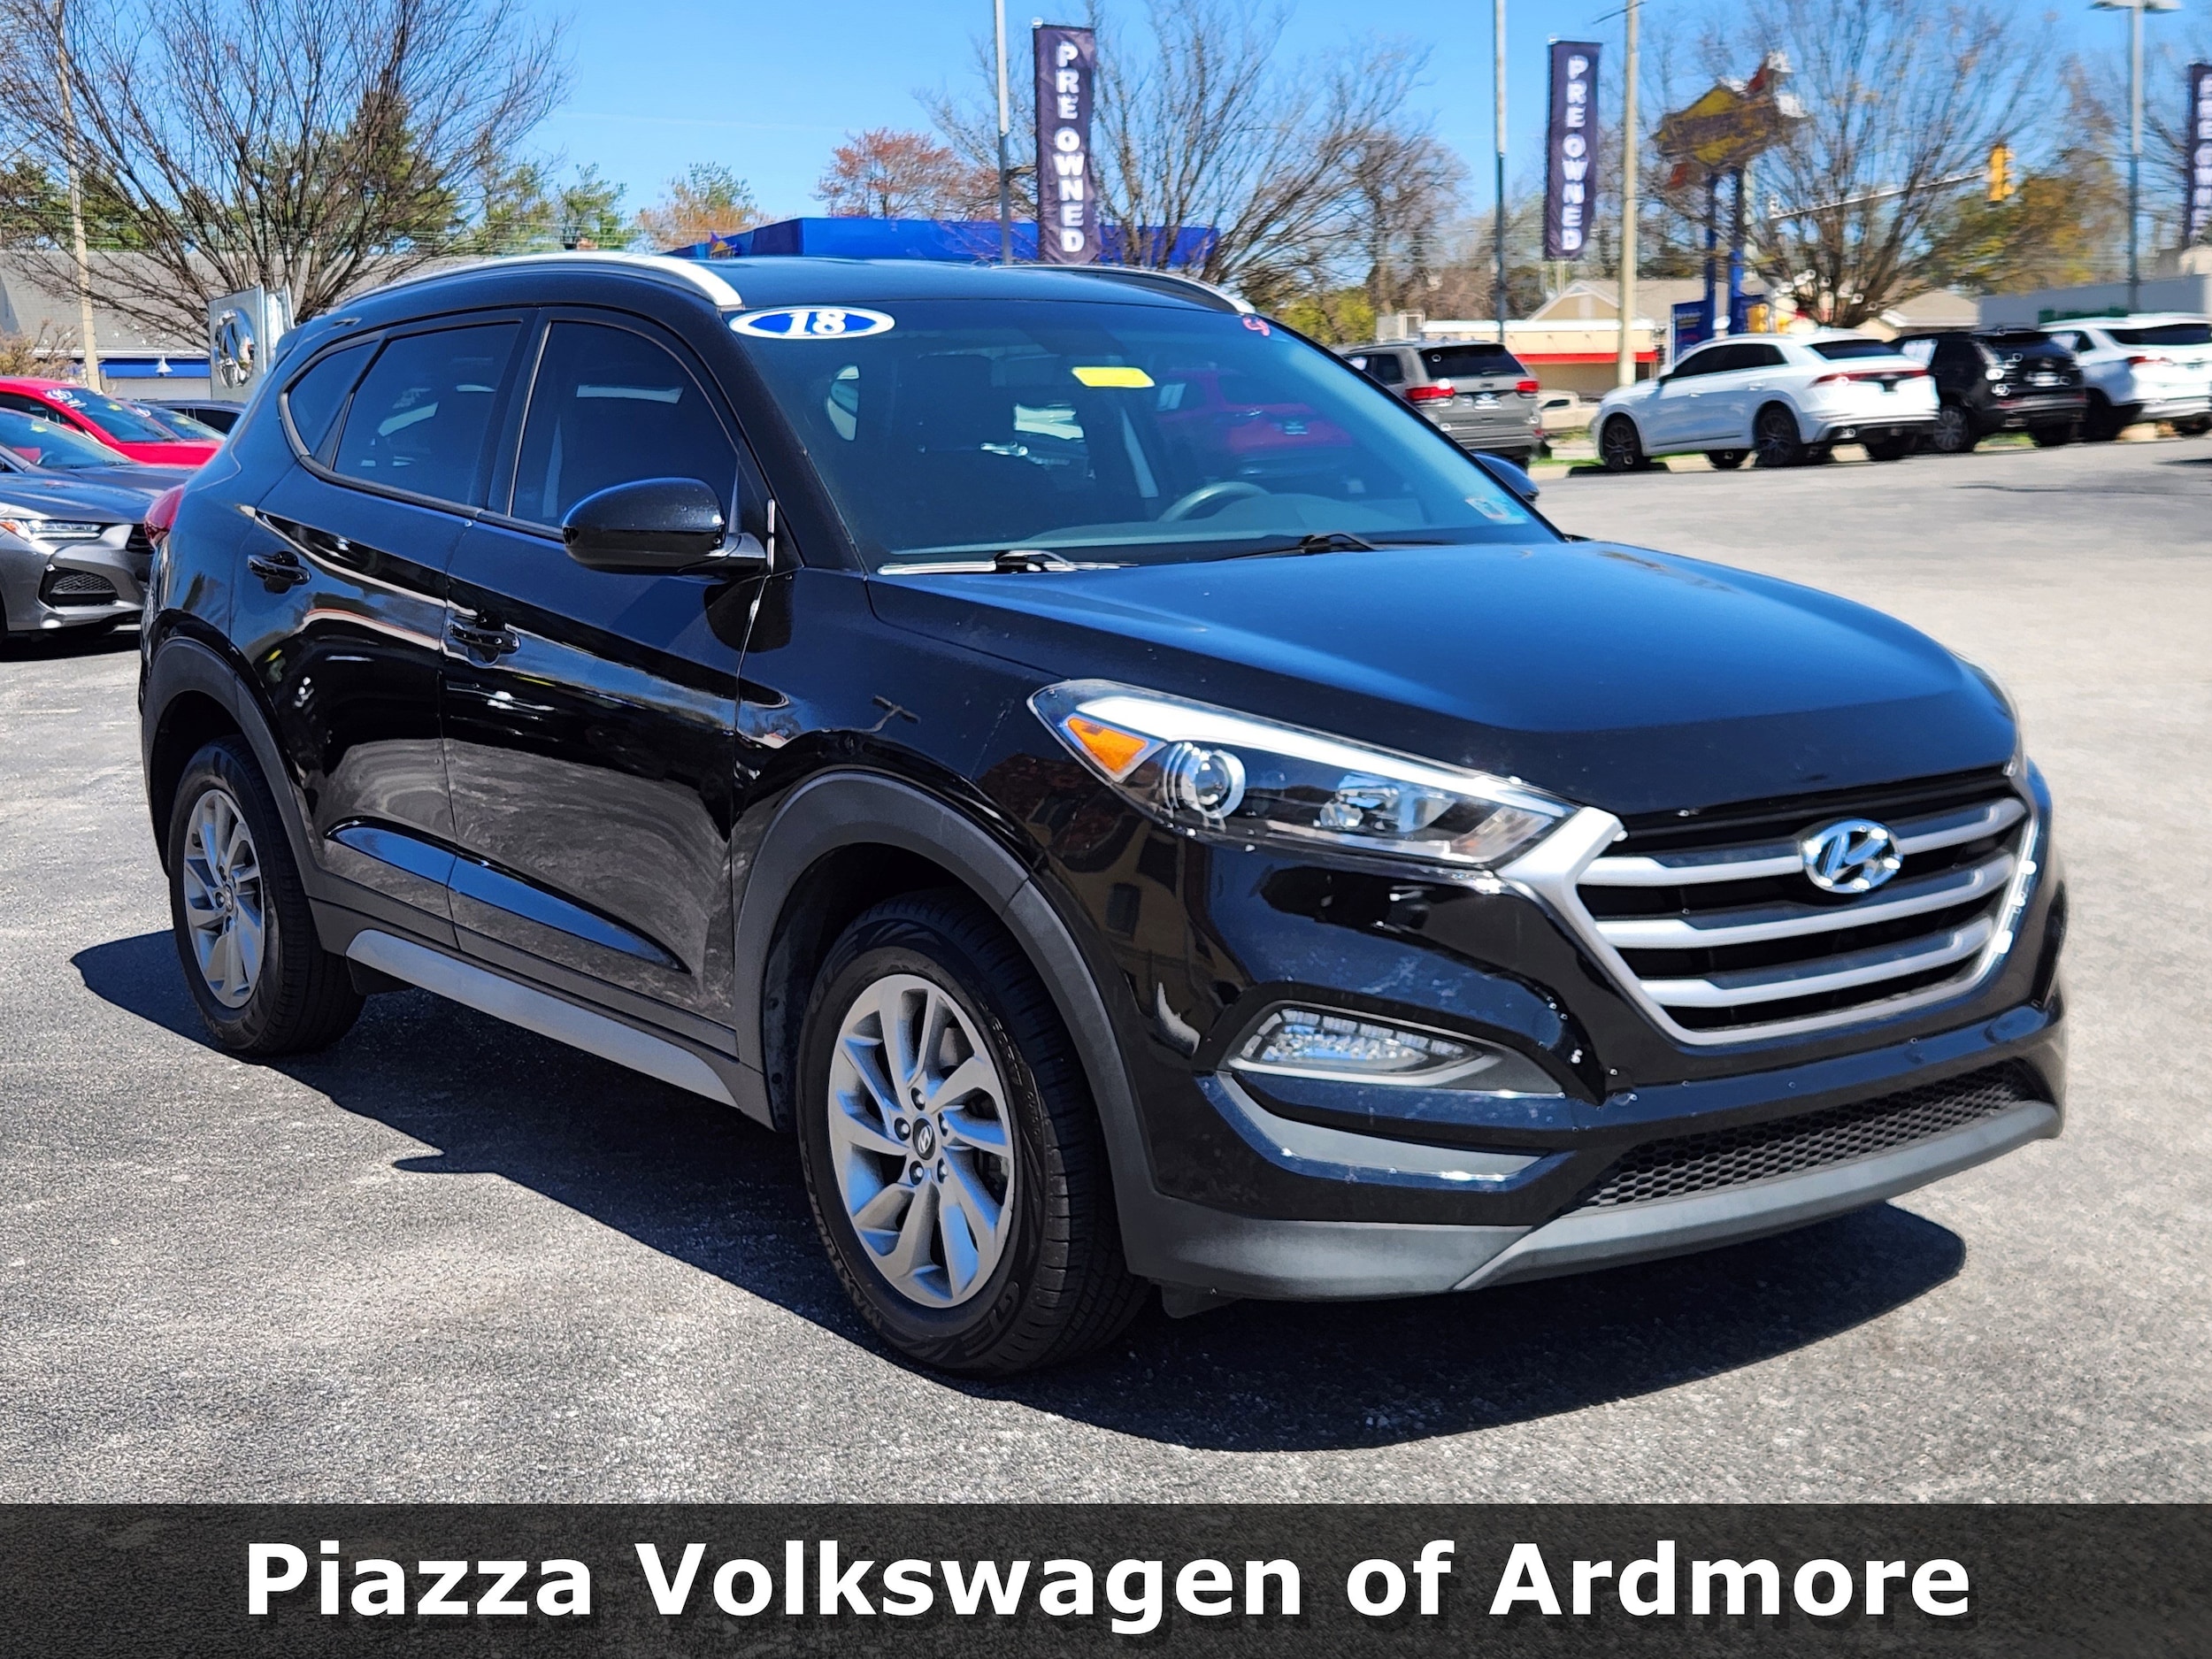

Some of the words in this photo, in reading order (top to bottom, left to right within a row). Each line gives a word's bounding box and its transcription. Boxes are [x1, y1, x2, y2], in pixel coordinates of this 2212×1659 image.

[1056, 41, 1079, 119] PRE
[1565, 55, 1589, 127] PRE
[1053, 127, 1085, 252] OWNED
[1561, 134, 1589, 250] OWNED
[785, 311, 847, 336] 18
